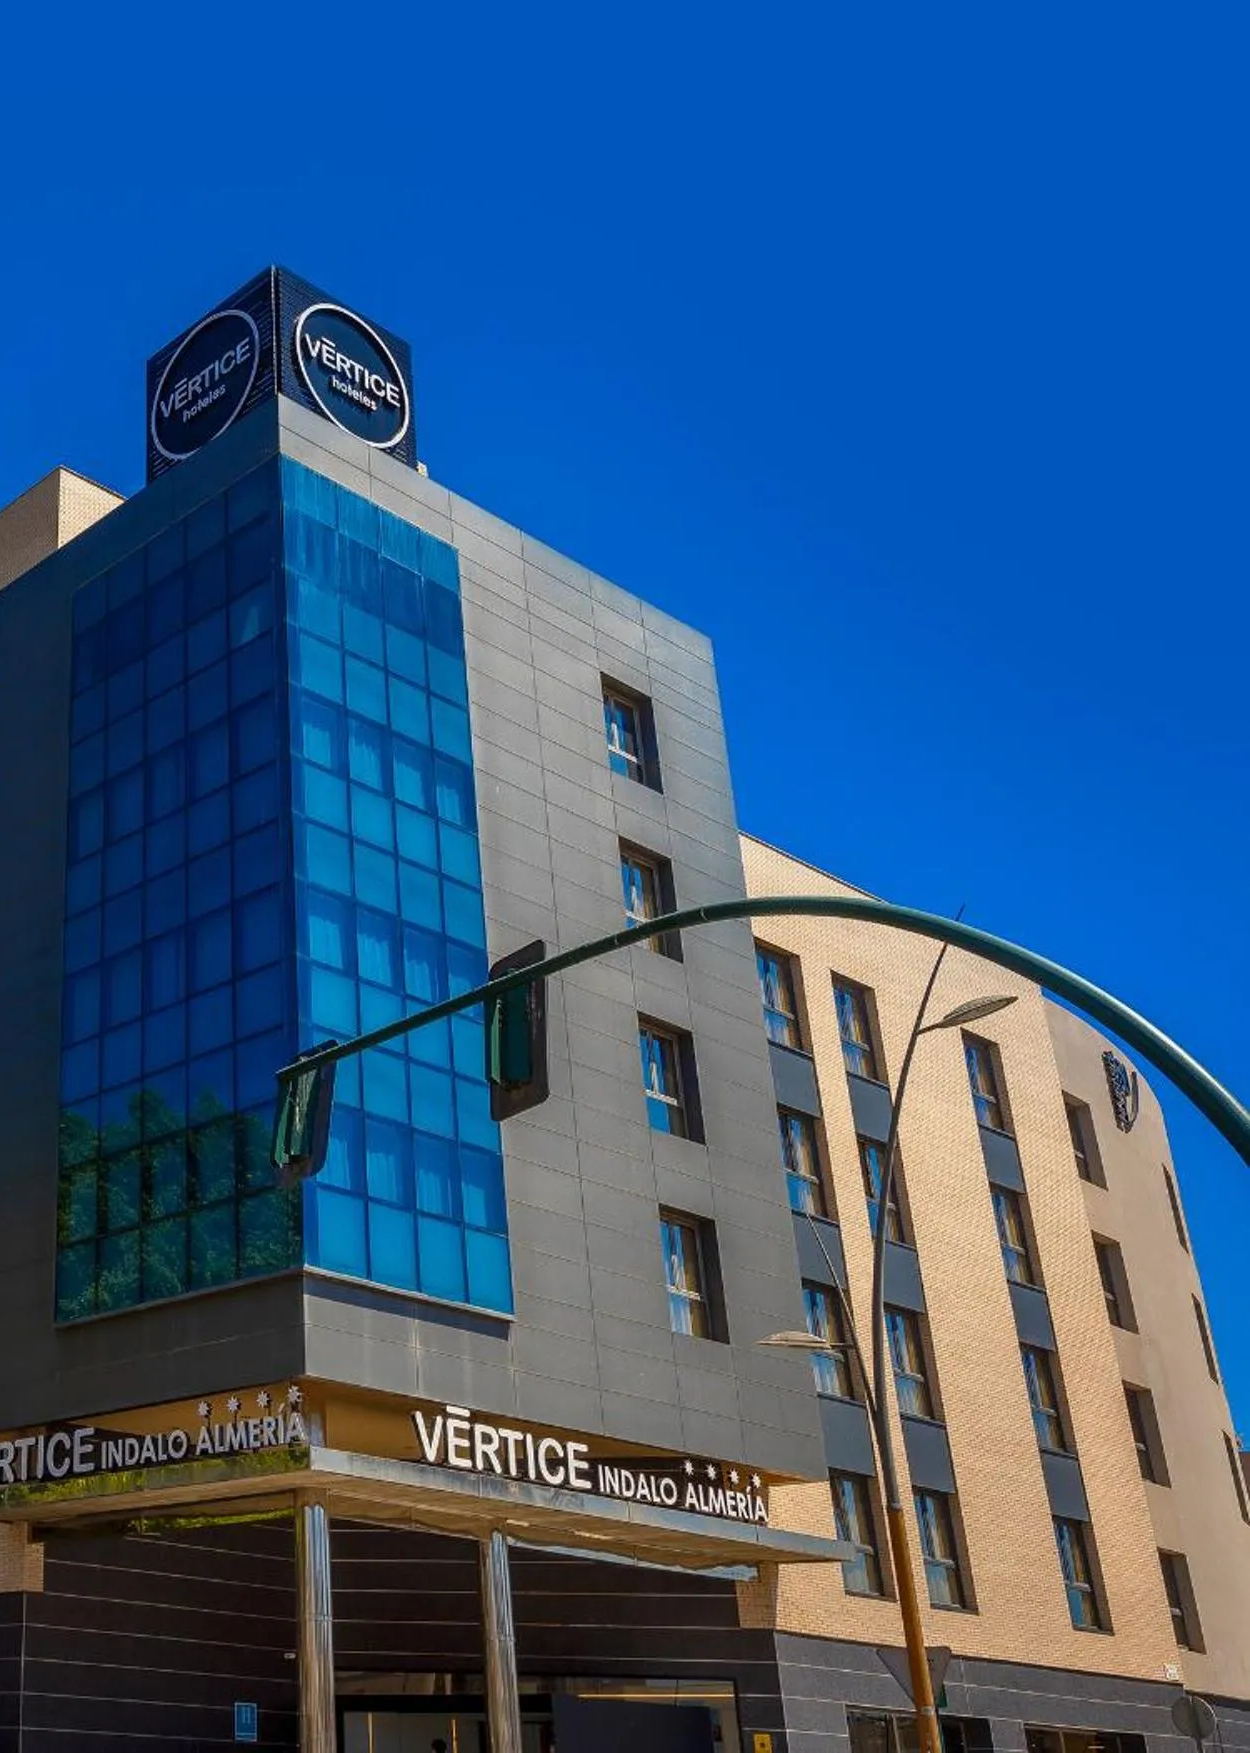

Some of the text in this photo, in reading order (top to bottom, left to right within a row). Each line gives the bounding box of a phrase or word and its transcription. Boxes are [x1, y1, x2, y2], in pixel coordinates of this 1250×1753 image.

[182, 383, 228, 424] hoteles
[332, 374, 378, 413] hoteles
[102, 1429, 189, 1469] INDALO
[195, 1403, 310, 1456] ALMERÍA
[598, 1463, 678, 1506] INDALO
[684, 1484, 769, 1523] ALMERÍA
